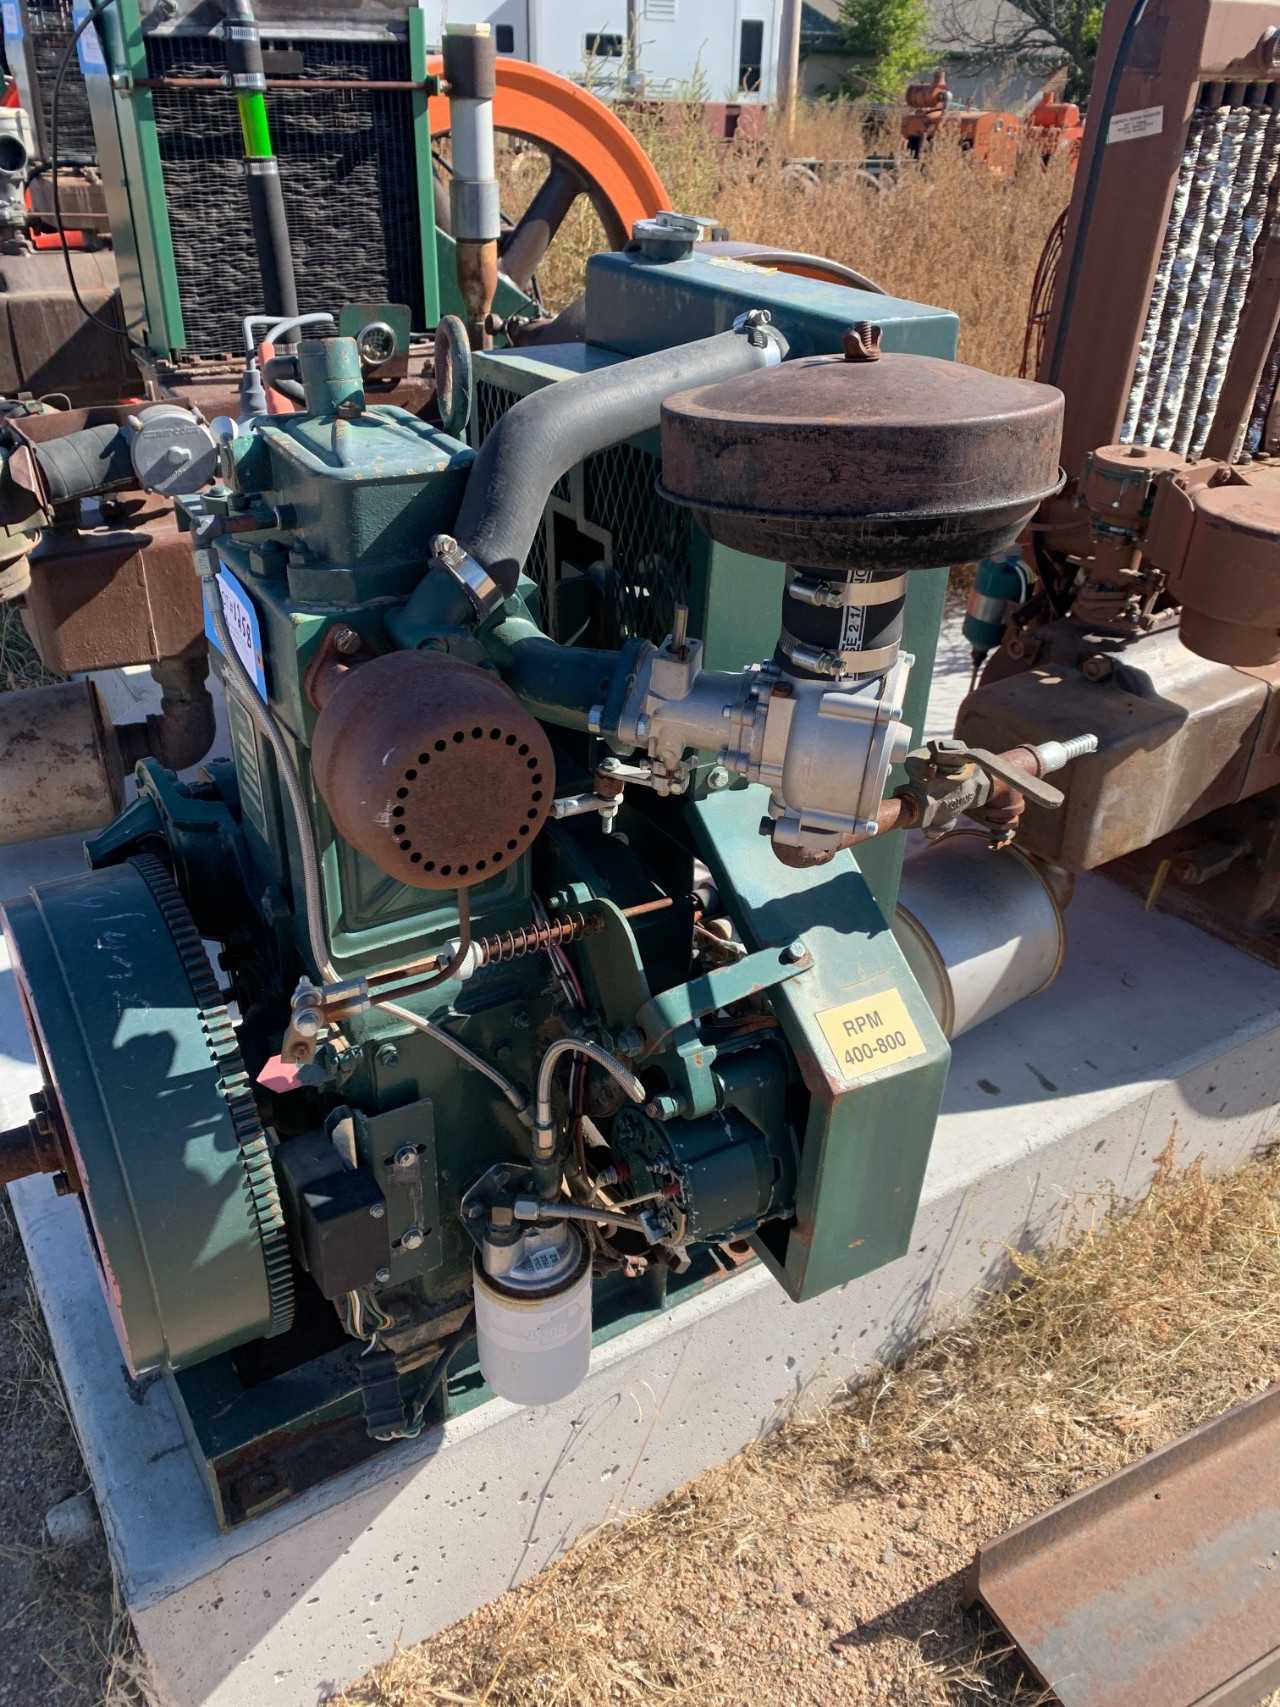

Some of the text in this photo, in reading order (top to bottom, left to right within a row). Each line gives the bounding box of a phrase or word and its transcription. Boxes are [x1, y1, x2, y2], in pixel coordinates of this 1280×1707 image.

[849, 623, 859, 632] 2
[842, 1010, 884, 1037] RPM
[845, 1031, 906, 1064] 400-800
